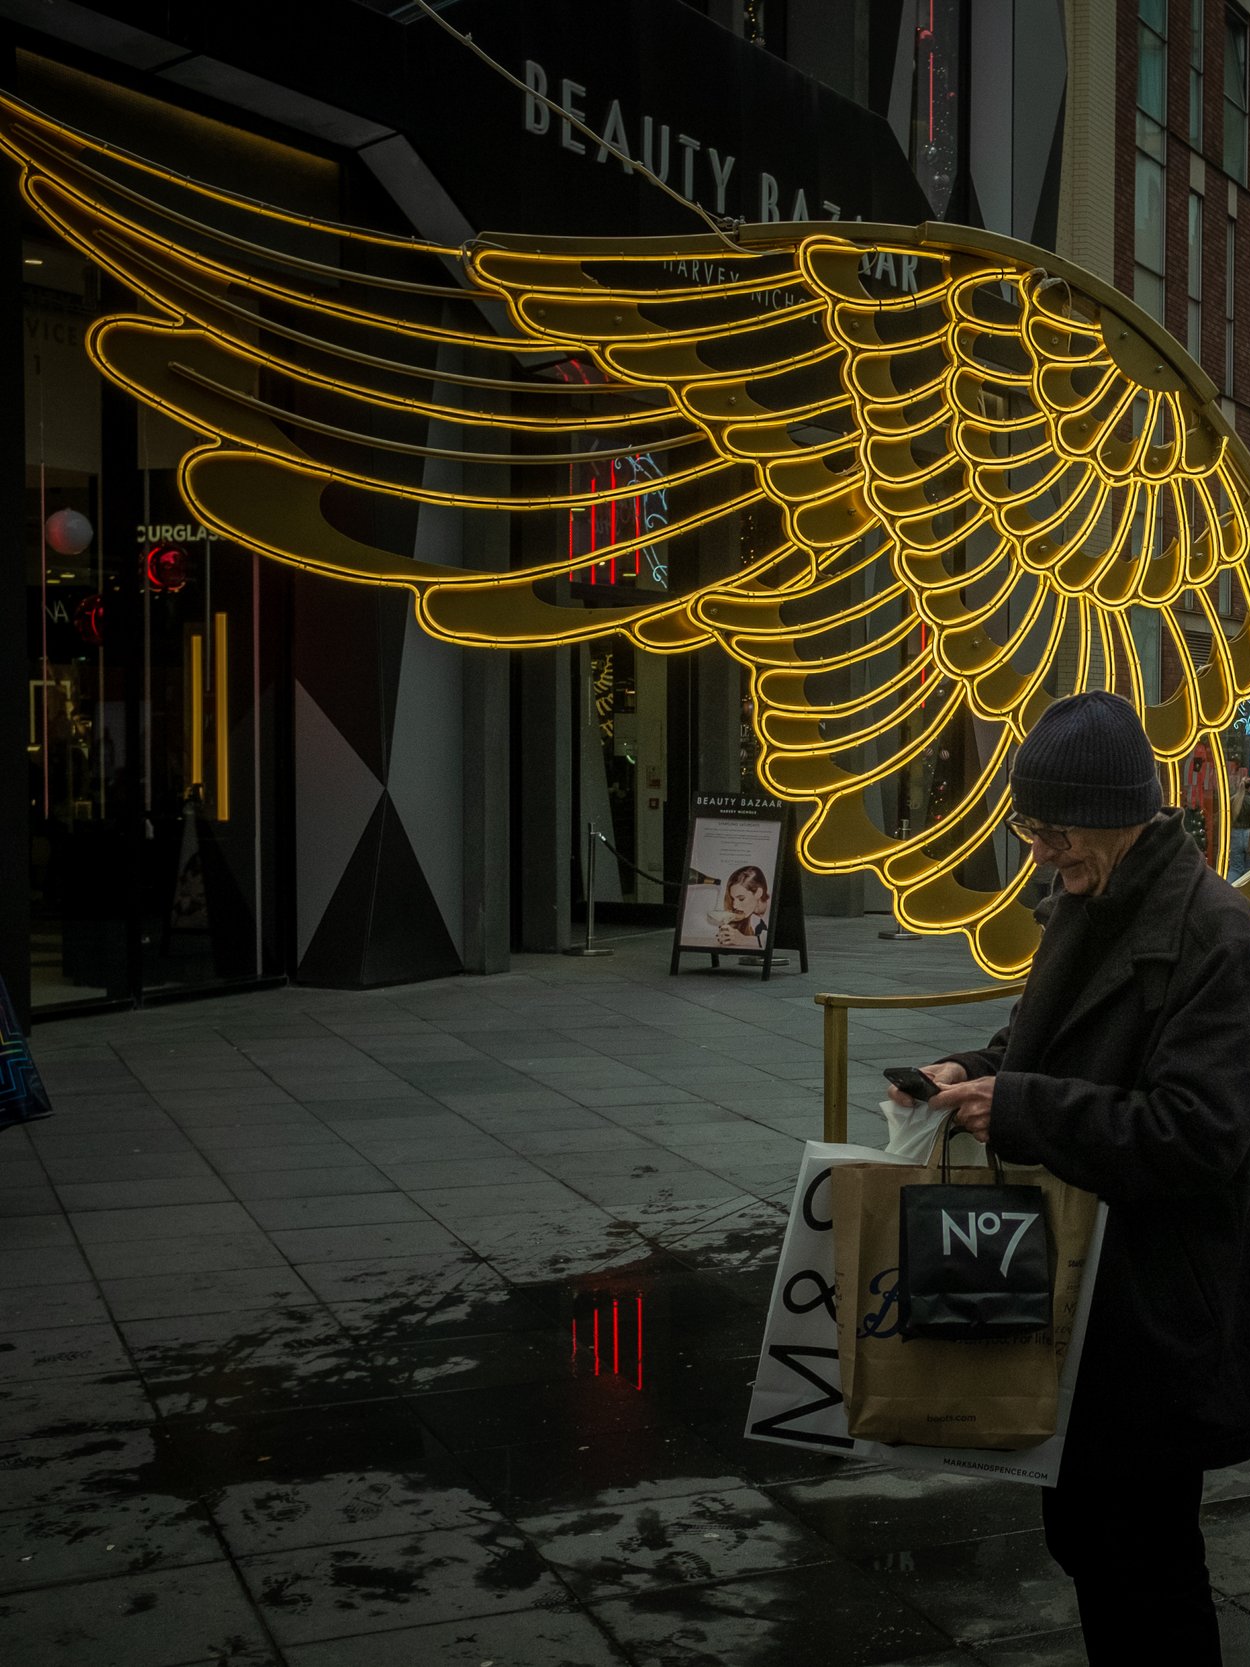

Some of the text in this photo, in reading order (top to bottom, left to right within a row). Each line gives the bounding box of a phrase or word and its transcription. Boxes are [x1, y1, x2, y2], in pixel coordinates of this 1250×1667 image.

[524, 59, 736, 217] BEAUTY
[696, 796, 783, 809] BEAUTY BAZAAR
[926, 1413, 977, 1423] boots.com
[943, 1457, 1049, 1481] MARKSANDSPENCER.COM
